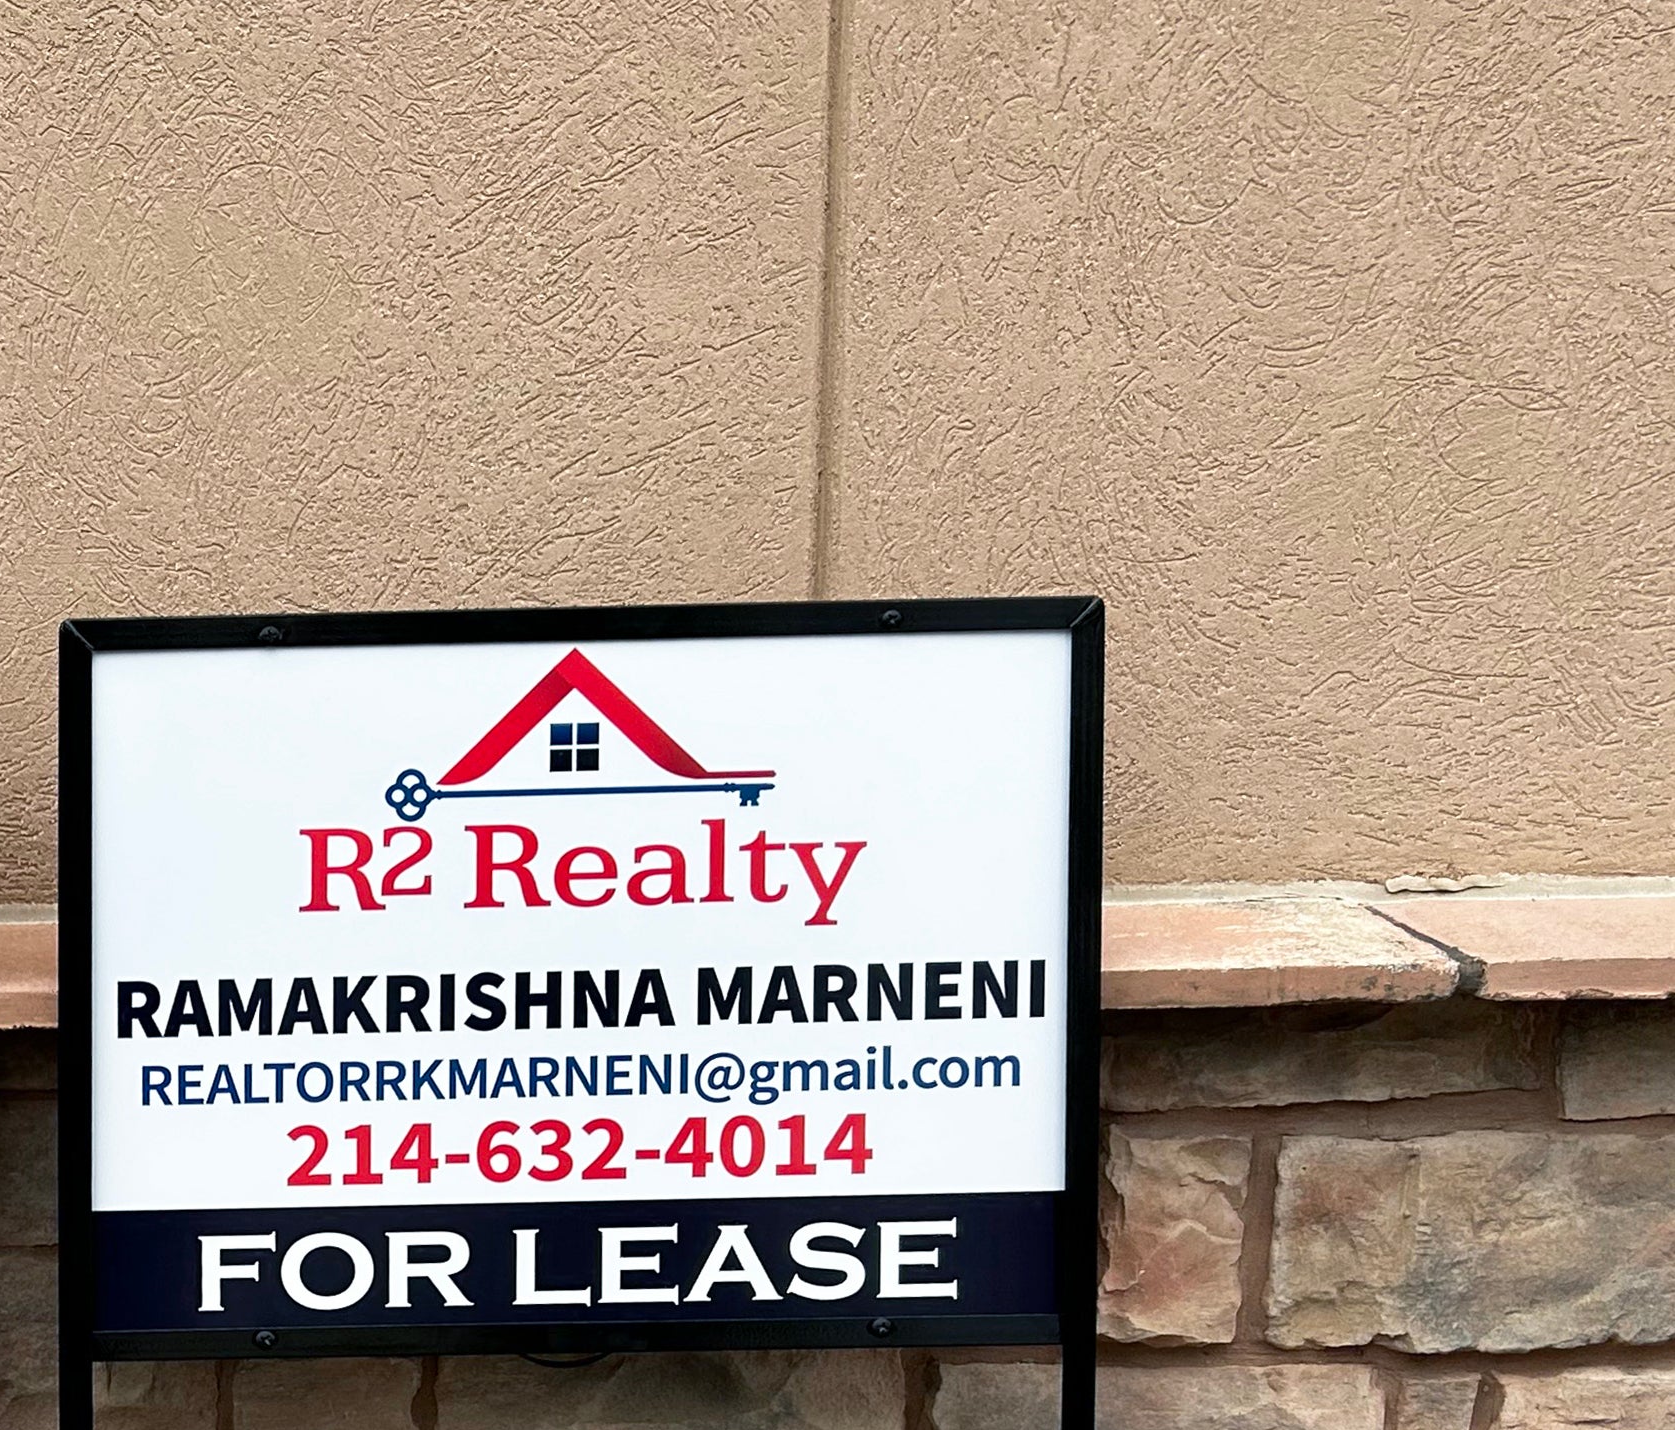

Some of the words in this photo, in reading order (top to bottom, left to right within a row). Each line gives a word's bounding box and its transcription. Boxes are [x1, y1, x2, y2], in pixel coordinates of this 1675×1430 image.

[299, 825, 433, 913] R2
[465, 818, 867, 926] Realty
[117, 968, 676, 1039] RAMAKRISHNA
[697, 959, 1046, 1026] MARNENI
[141, 1045, 1021, 1106] REALTORRKMARNENI@gmail.com
[286, 1113, 873, 1187] 214-632-4014
[197, 1230, 475, 1312] FOR
[512, 1216, 958, 1307] LEASE
